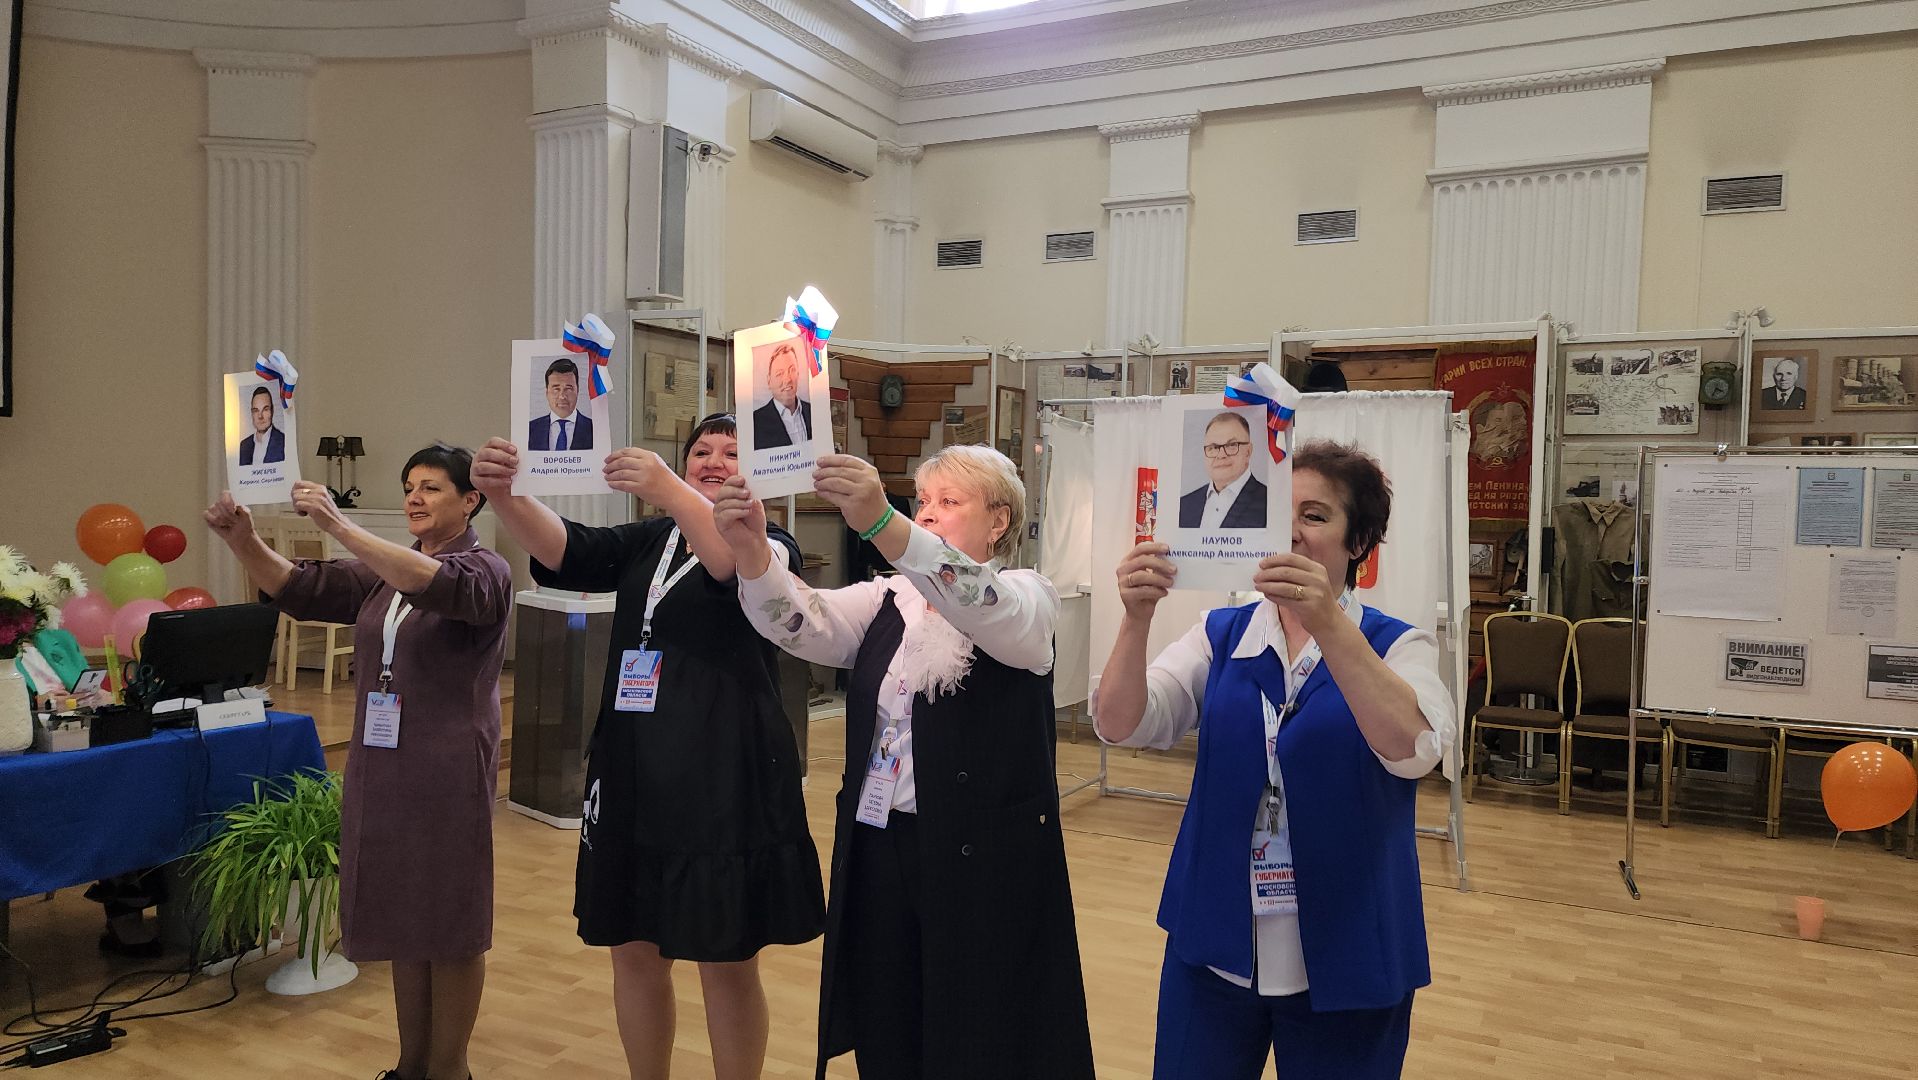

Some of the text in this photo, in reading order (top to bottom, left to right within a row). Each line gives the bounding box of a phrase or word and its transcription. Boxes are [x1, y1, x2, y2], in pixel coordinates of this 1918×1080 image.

[1468, 357, 1493, 372] ВСЕХ
[543, 456, 582, 464] ВОРОБЬЕВ
[769, 450, 801, 463] НИКИТИН
[530, 467, 591, 475] Андрей Юрьевич
[752, 460, 815, 477] Анатолий Юрьевич
[1201, 536, 1243, 545] НАУМОВ
[1728, 641, 1804, 657] ВНИМАНИЕ!
[1760, 665, 1801, 676] ВЕДЕТСЯ
